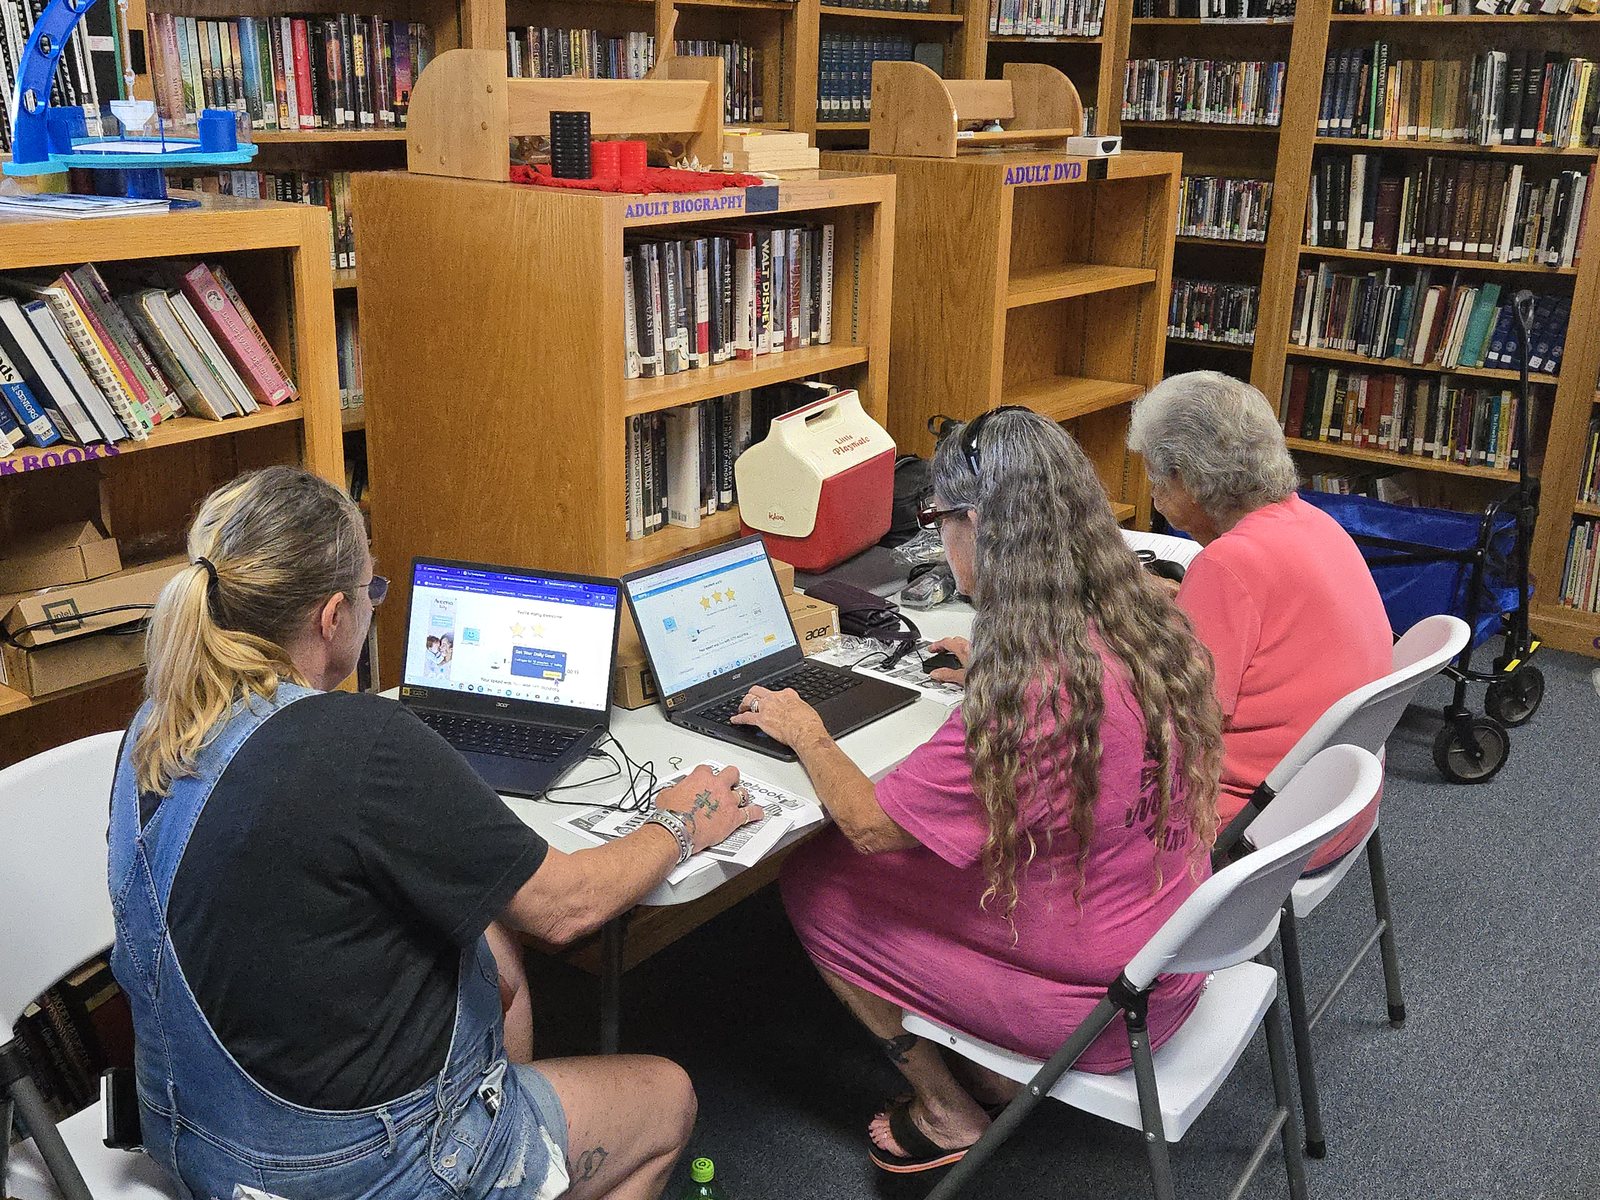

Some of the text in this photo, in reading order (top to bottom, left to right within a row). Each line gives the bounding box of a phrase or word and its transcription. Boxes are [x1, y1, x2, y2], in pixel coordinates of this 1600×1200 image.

[1004, 162, 1082, 185] ADULT DVD
[625, 194, 744, 218] ADULT BIOGRAPHY
[762, 239, 770, 332] WALT DISNEY
[137, 343, 169, 392] family dinners
[16, 389, 40, 420] SENIORS
[21, 442, 120, 472] BOOKS
[832, 436, 870, 455] Playmate
[53, 609, 74, 620] intel
[805, 624, 830, 641] acer
